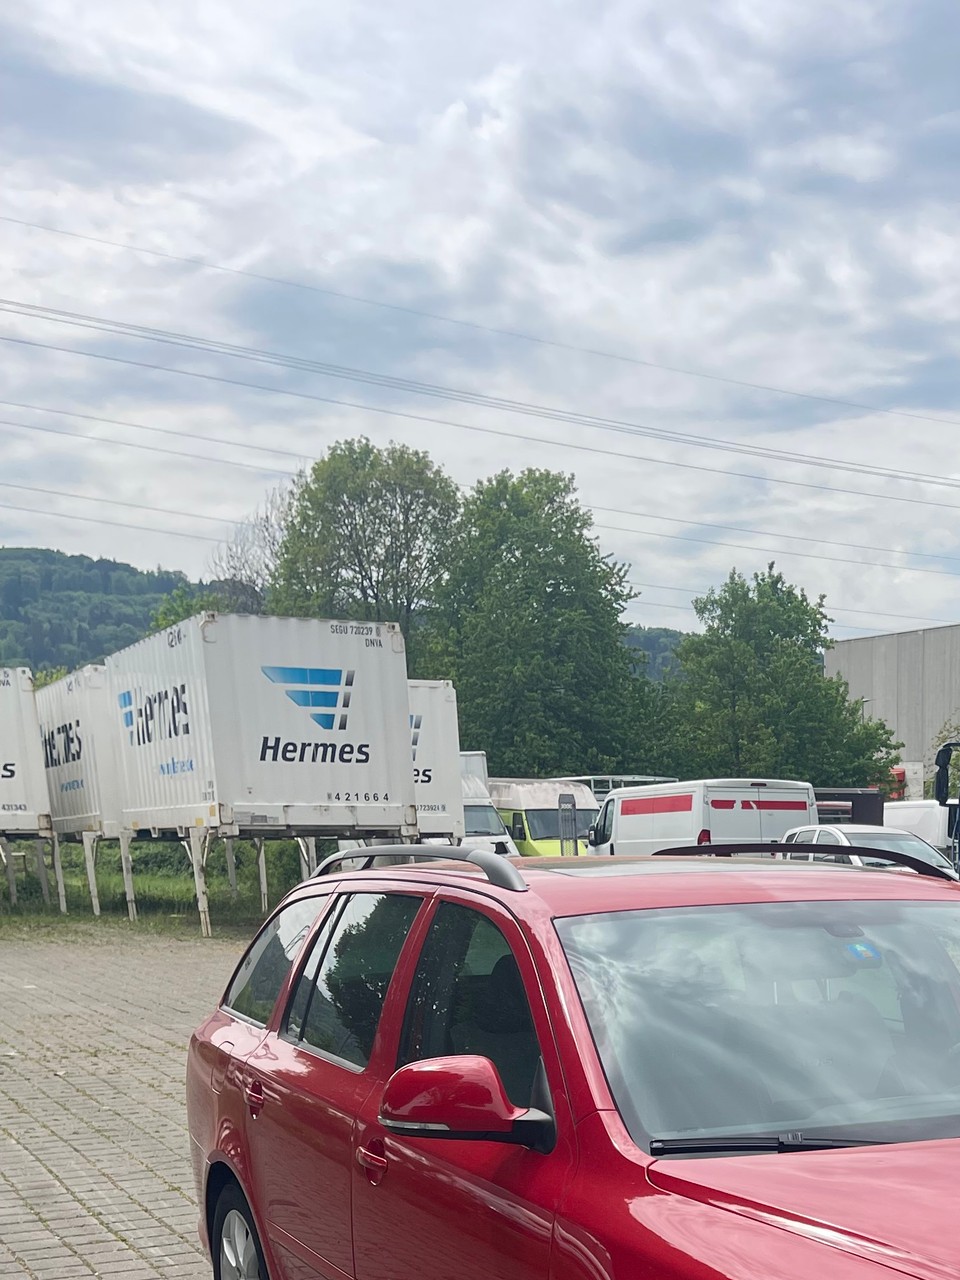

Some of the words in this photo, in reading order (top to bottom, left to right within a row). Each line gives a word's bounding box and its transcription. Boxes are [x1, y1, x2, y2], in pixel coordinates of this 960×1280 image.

[330, 624, 348, 634] SEGU
[259, 736, 370, 763] Hermes
[334, 792, 389, 801] 421664
